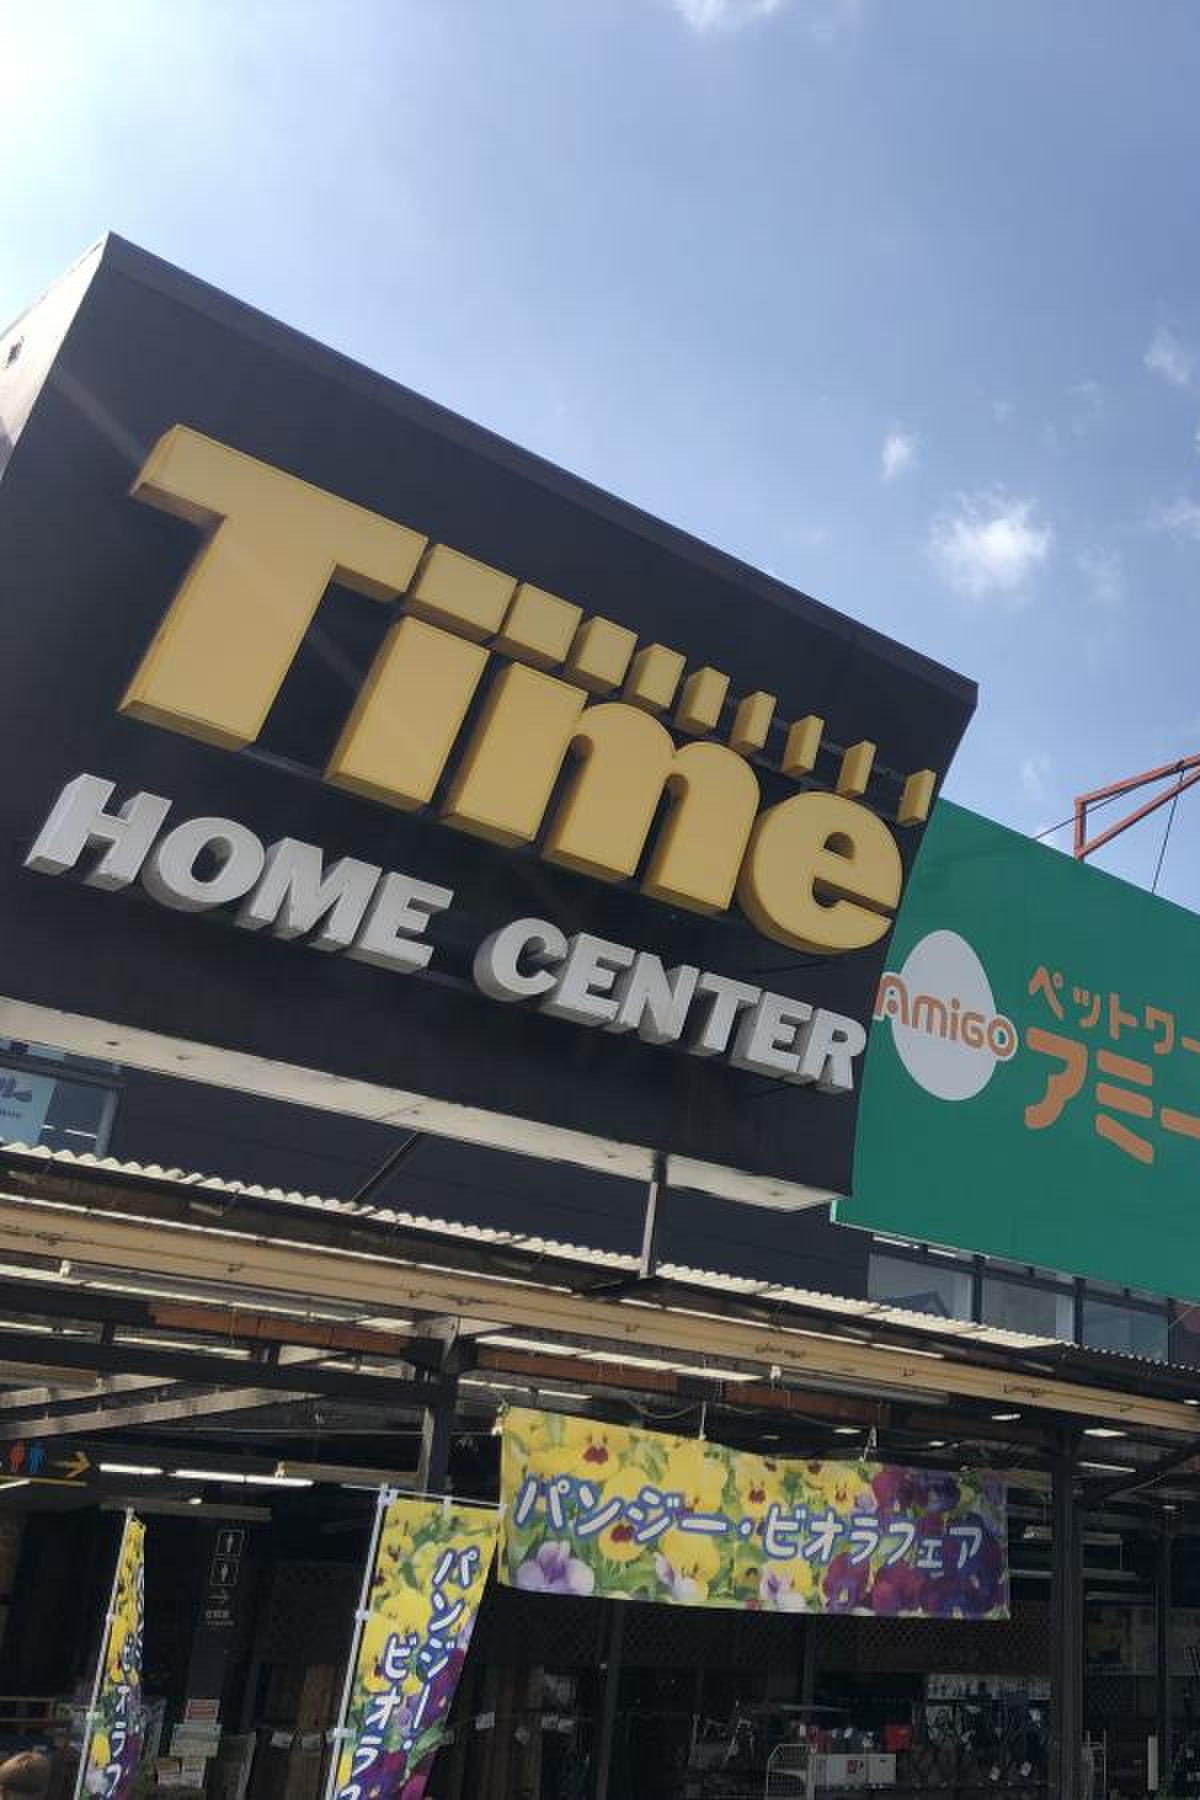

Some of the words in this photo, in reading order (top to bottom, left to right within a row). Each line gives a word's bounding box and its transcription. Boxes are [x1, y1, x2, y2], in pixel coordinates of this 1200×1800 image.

[118, 424, 905, 954] Time
[24, 773, 454, 974] HOME
[474, 917, 866, 1093] CENTER
